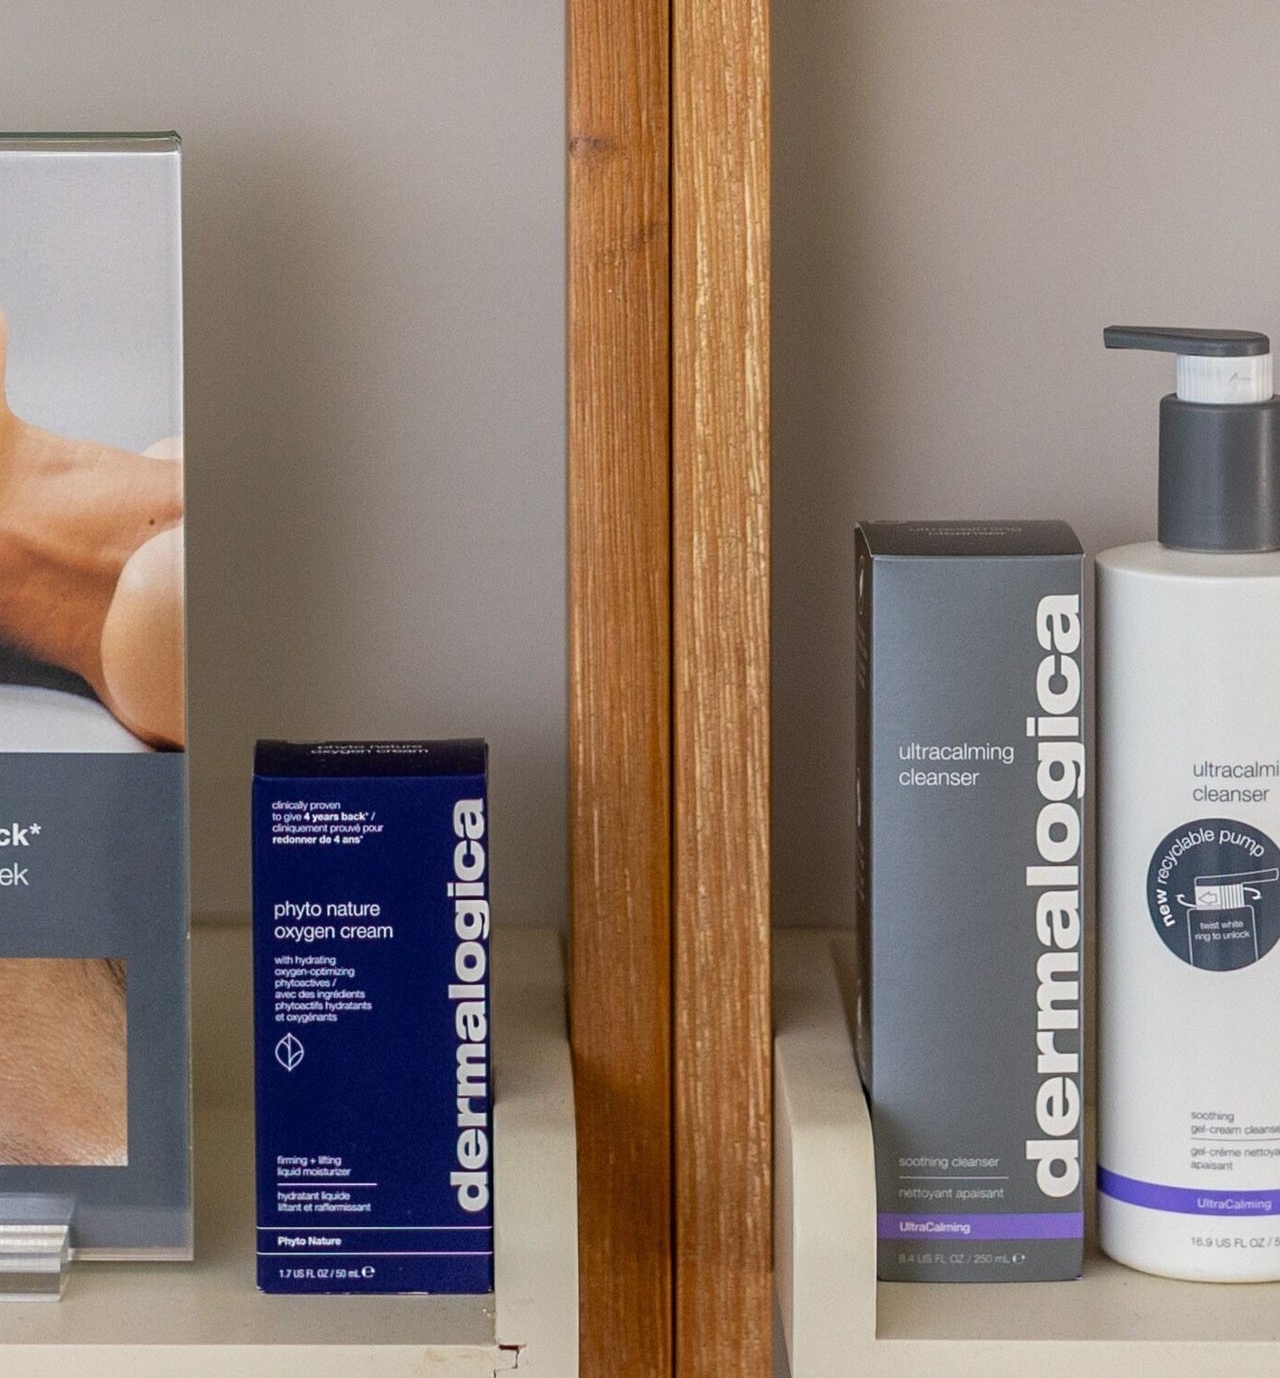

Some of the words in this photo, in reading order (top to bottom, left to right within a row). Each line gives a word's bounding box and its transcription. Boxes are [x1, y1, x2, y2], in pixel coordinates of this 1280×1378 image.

[899, 743, 1014, 763] ultracalming
[899, 770, 979, 786] cleanser
[1025, 593, 1085, 1199] dermalogica
[274, 901, 322, 919] phyto
[327, 901, 380, 916] nature
[275, 926, 335, 942] oxygen
[340, 925, 393, 938] cream
[447, 798, 490, 1212] dermalogica
[899, 1221, 971, 1235] UltraCalming
[278, 1236, 306, 1246] Phyto
[308, 1237, 341, 1245] Nature
